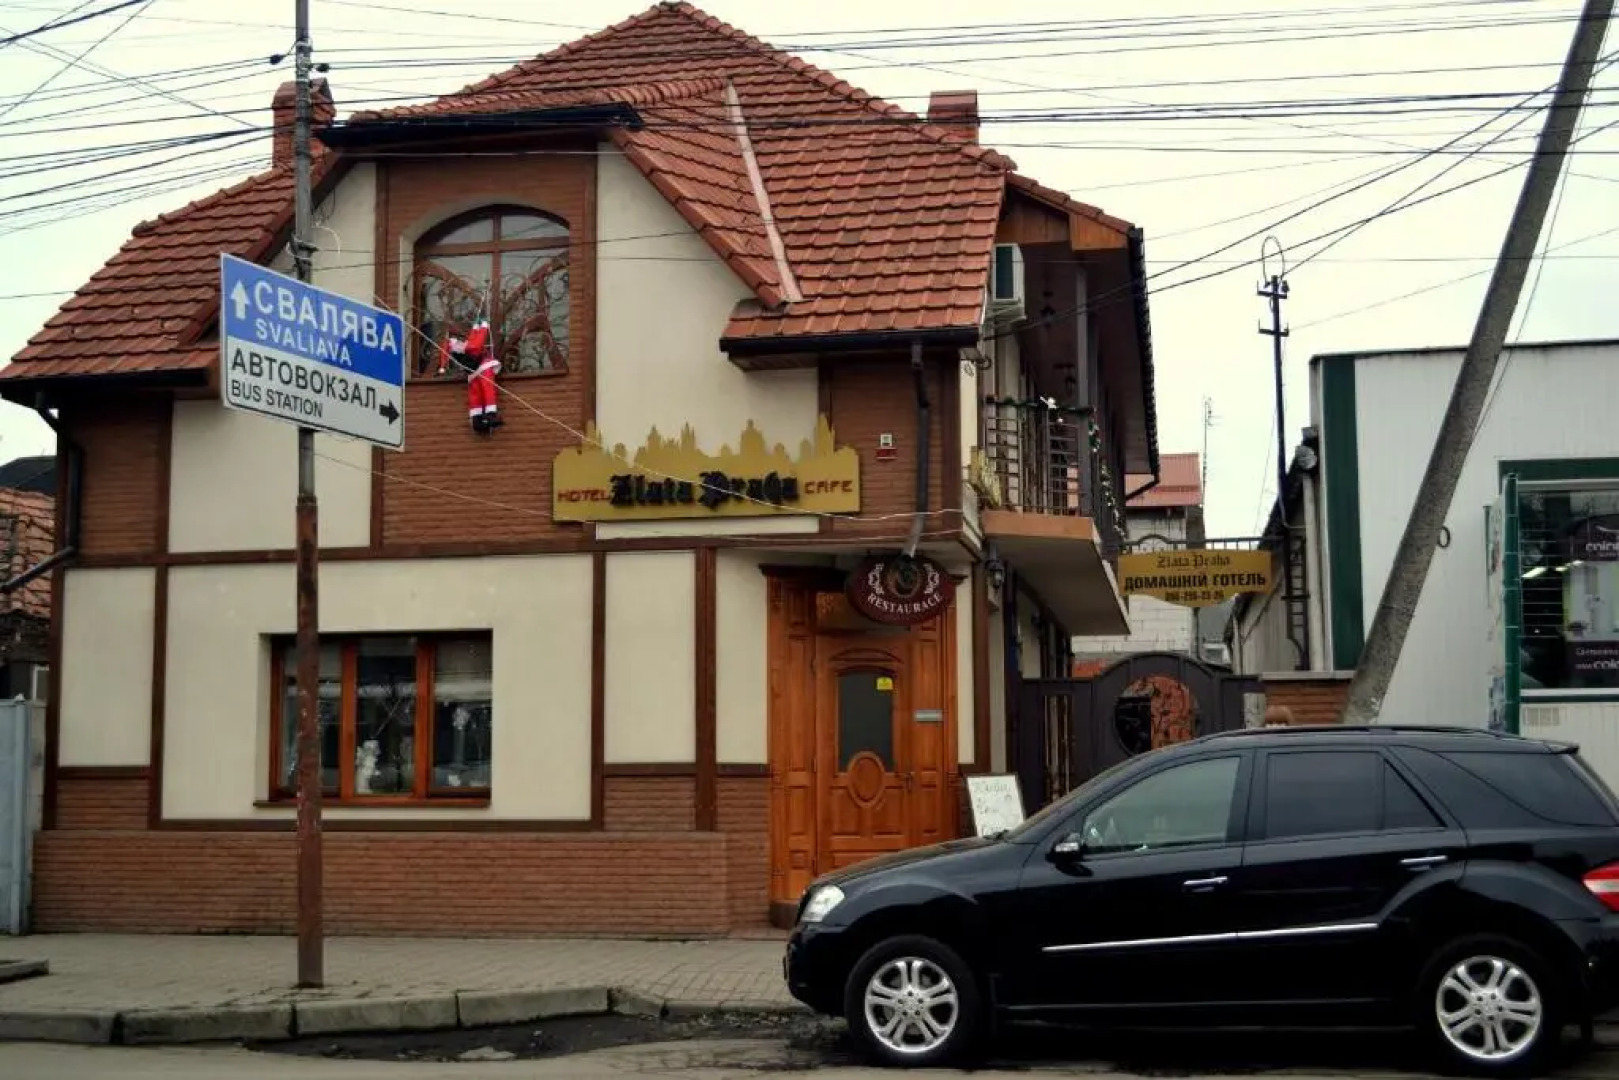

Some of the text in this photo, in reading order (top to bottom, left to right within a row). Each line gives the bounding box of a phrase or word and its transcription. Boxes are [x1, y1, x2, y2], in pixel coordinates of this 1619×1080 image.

[254, 280, 398, 355] СВАЛЯВА
[255, 318, 352, 367] SVALIAVA
[232, 348, 377, 411] АВТОВОКЗАЛ
[232, 380, 324, 418] BUS STATION
[558, 488, 610, 502] HOTEL
[804, 479, 854, 495] CAFE
[1124, 572, 1266, 591] ДОМАШНІЙ ГОТЕЛЬ
[867, 592, 942, 614] RESTAURACE
